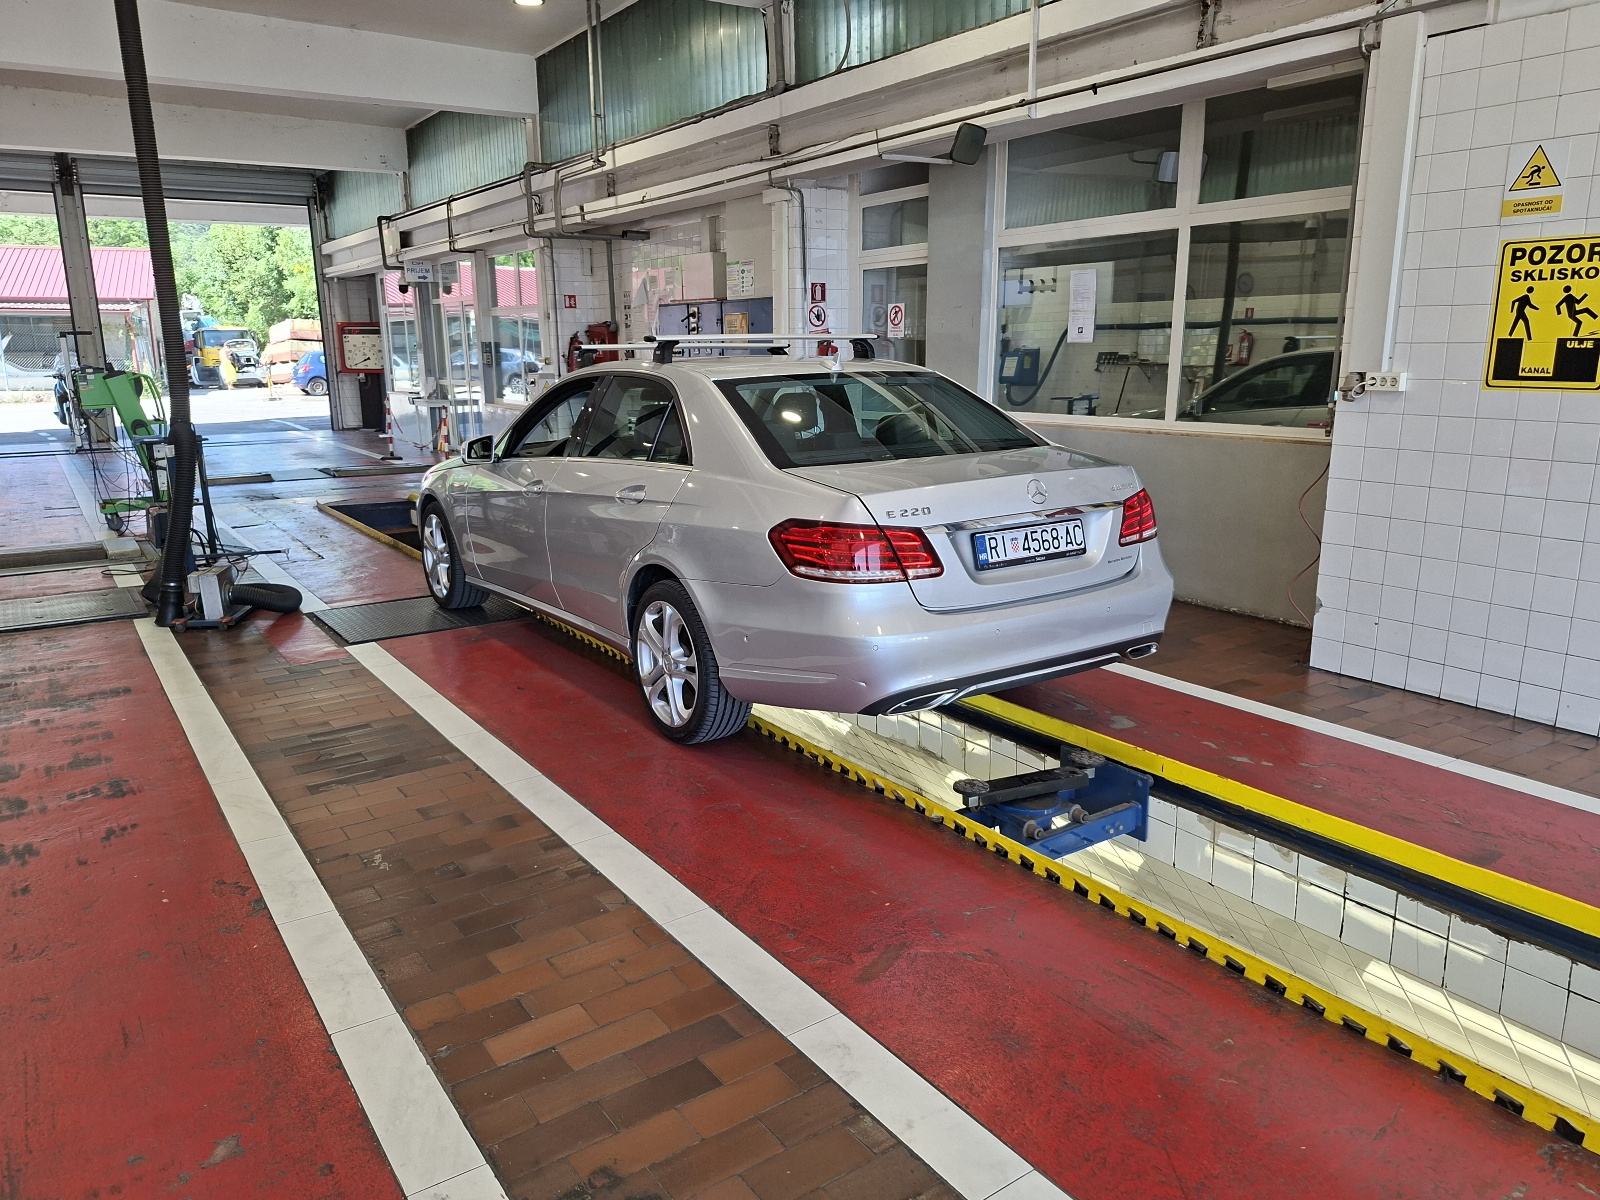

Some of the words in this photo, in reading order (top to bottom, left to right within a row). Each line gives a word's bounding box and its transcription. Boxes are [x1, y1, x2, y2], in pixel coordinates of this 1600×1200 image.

[1513, 200, 1544, 208] OPASNOST
[1510, 243, 1600, 266] POZOR
[1510, 266, 1600, 282] SKLISKO
[1566, 340, 1594, 348] ULJE
[1520, 367, 1551, 375] KANAL
[886, 510, 896, 519] E
[900, 506, 931, 518] 220
[987, 535, 1008, 560] RI
[979, 552, 988, 560] HR
